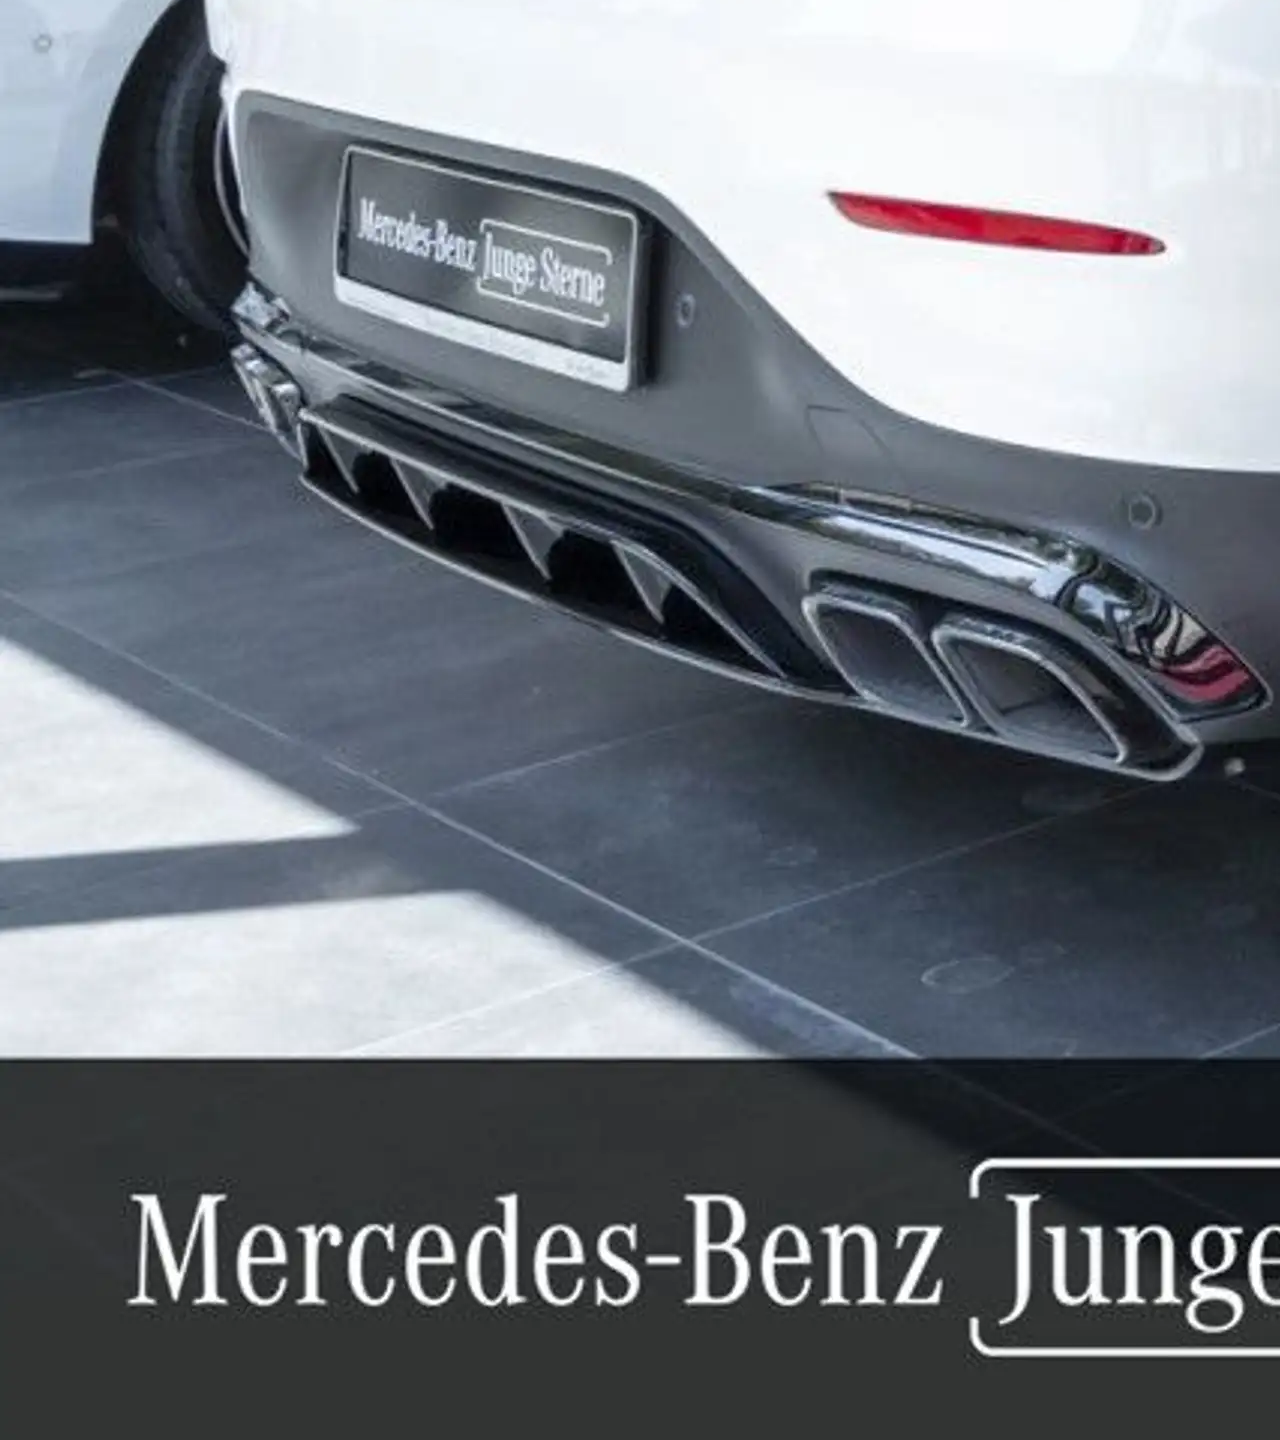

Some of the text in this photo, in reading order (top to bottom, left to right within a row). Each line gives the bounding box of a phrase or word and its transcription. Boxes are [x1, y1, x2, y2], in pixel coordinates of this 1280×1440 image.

[357, 196, 606, 307] Mercedes-Benz Junge Sterne
